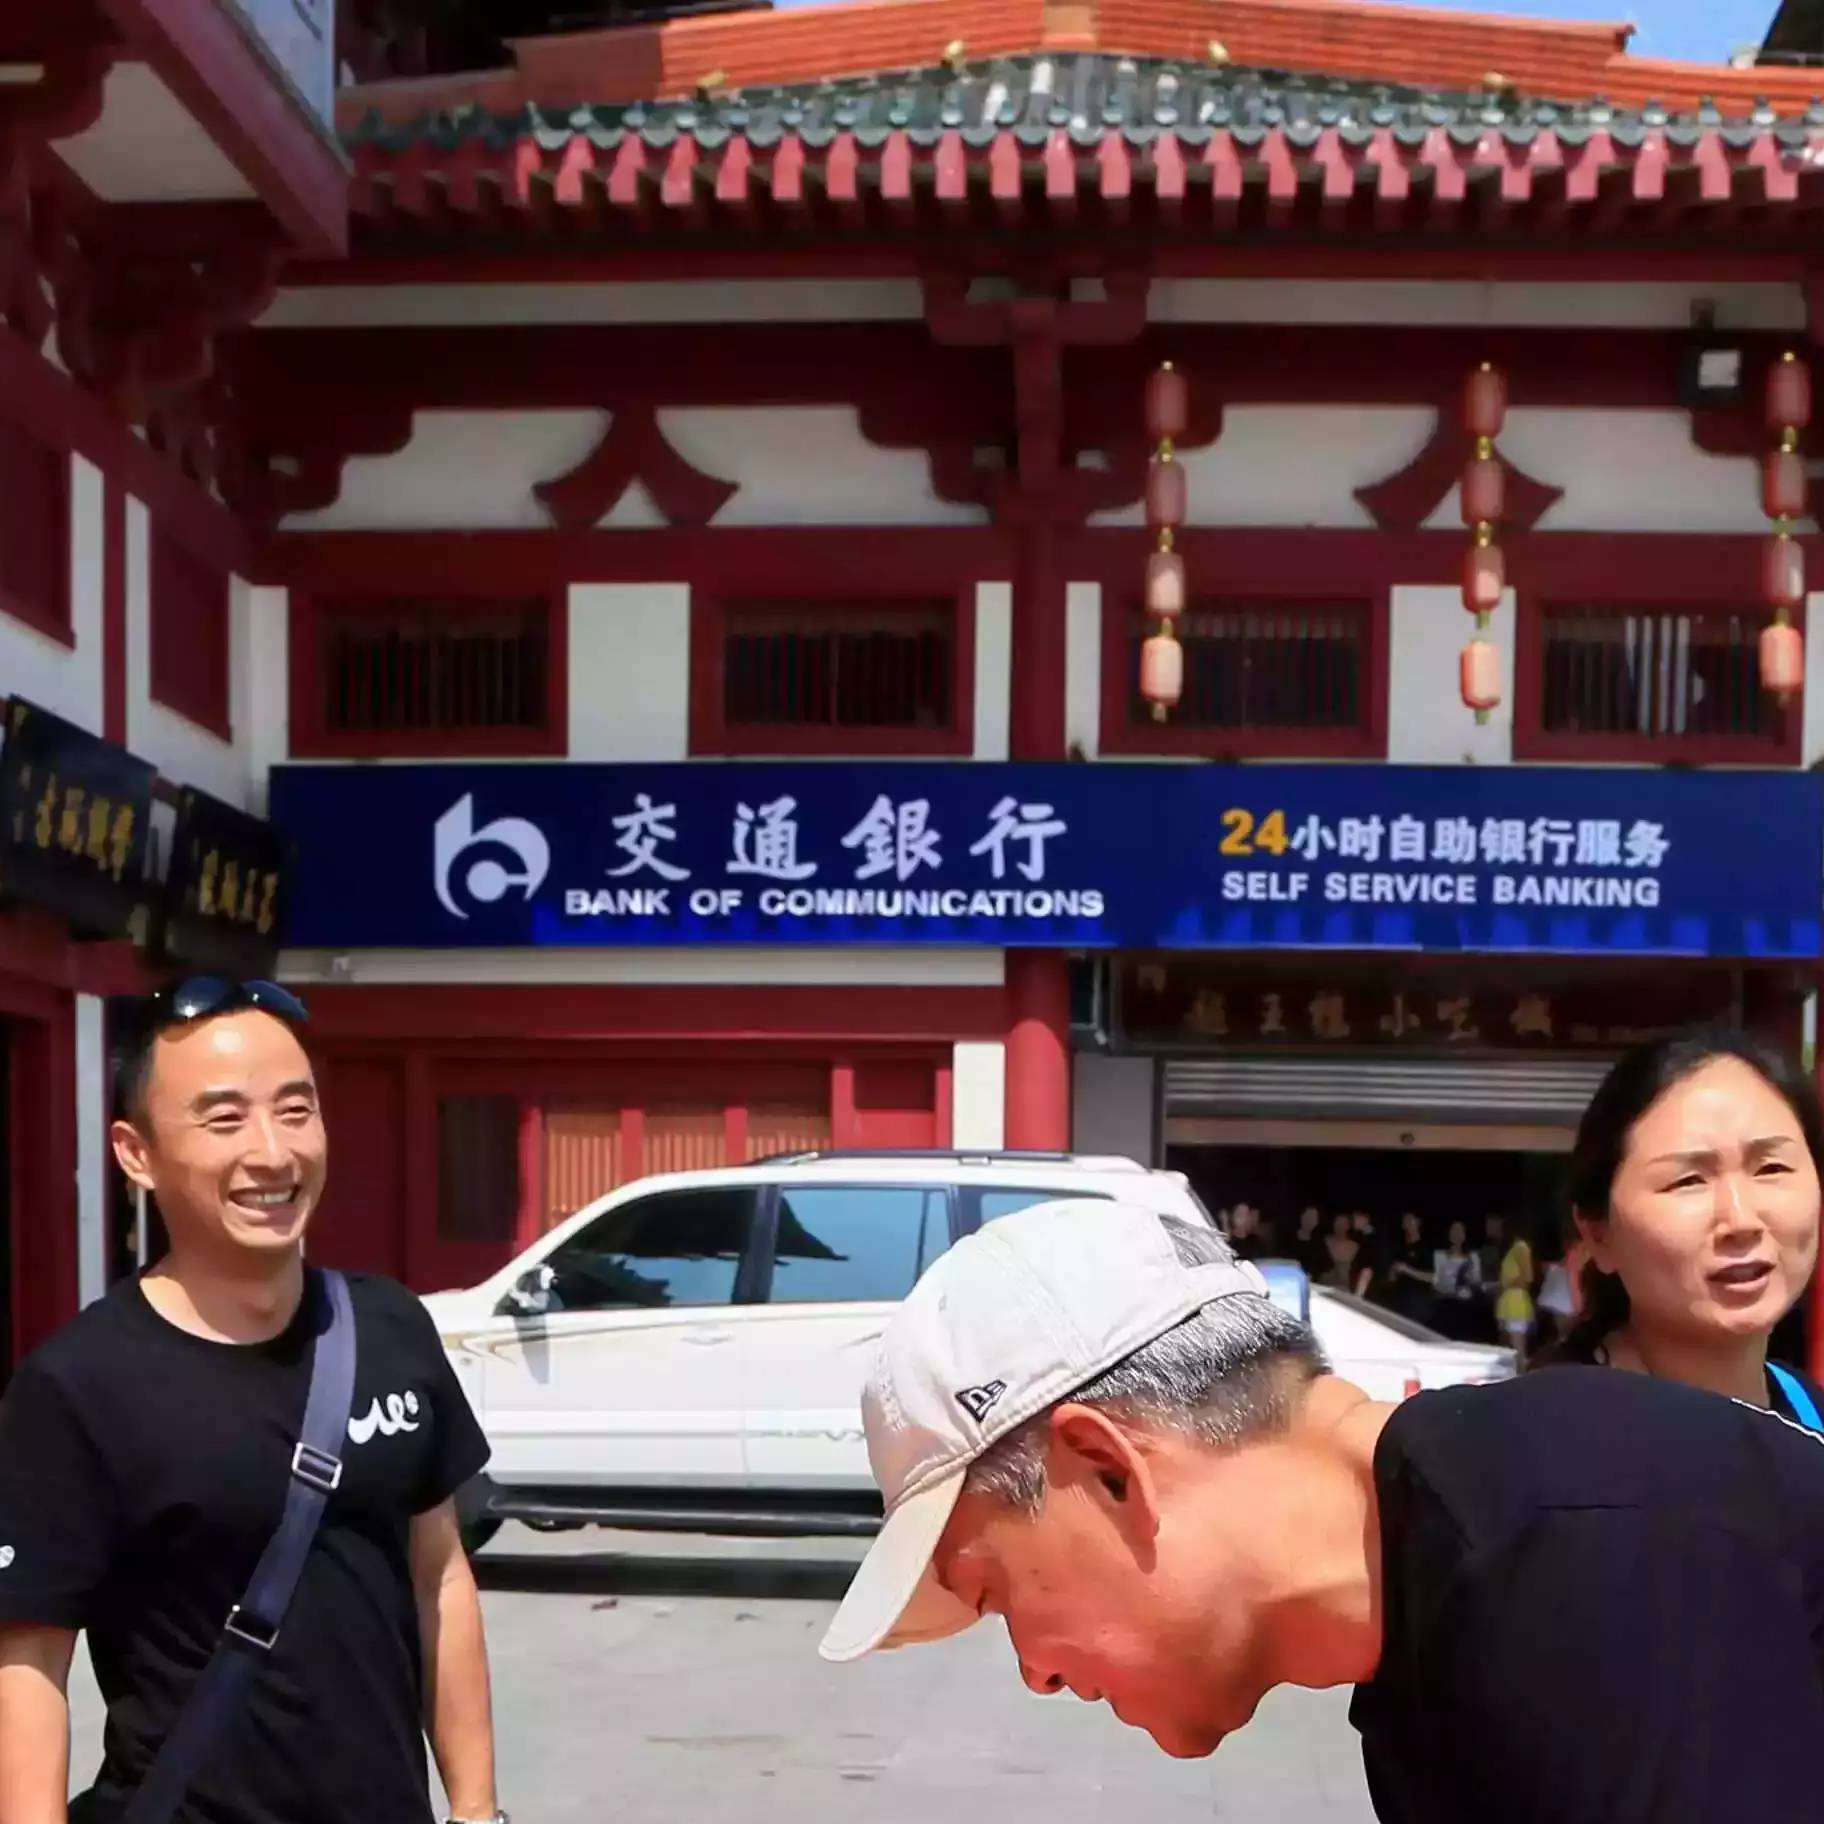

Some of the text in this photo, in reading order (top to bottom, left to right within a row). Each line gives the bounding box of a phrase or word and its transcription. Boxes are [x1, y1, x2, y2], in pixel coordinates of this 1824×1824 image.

[605, 793, 1068, 882] 交通銀行
[1219, 808, 1670, 867] 24小时自助银行服务
[564, 888, 1106, 918] BANK OF COMMUNICATIONS
[1221, 871, 1661, 907] SELF SERVICE BANKING
